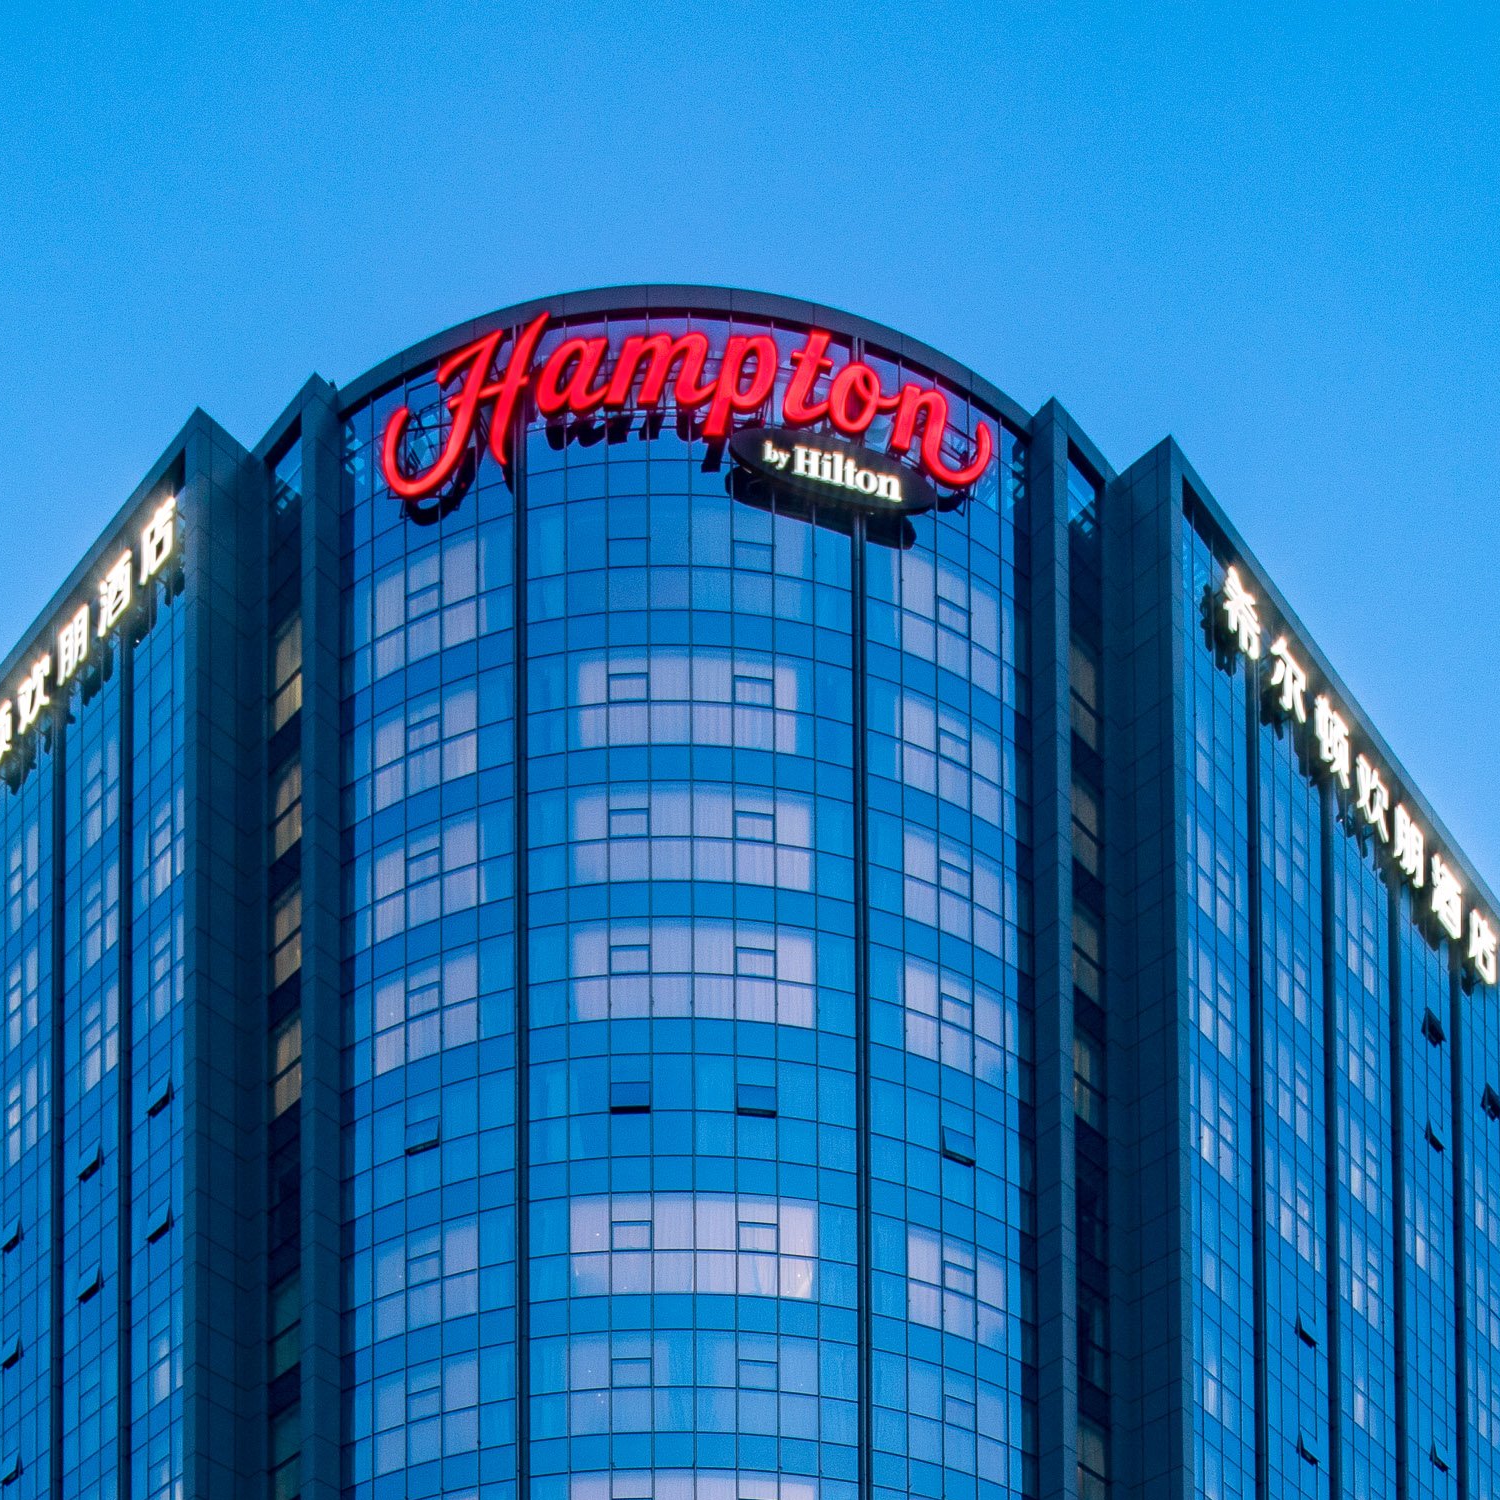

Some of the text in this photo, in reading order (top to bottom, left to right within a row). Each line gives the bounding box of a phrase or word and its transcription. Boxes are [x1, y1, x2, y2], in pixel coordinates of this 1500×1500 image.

[382, 311, 992, 496] Hampton
[764, 440, 902, 501] by Hilton
[1223, 566, 1498, 985] 希尔顿欢朋酒店
